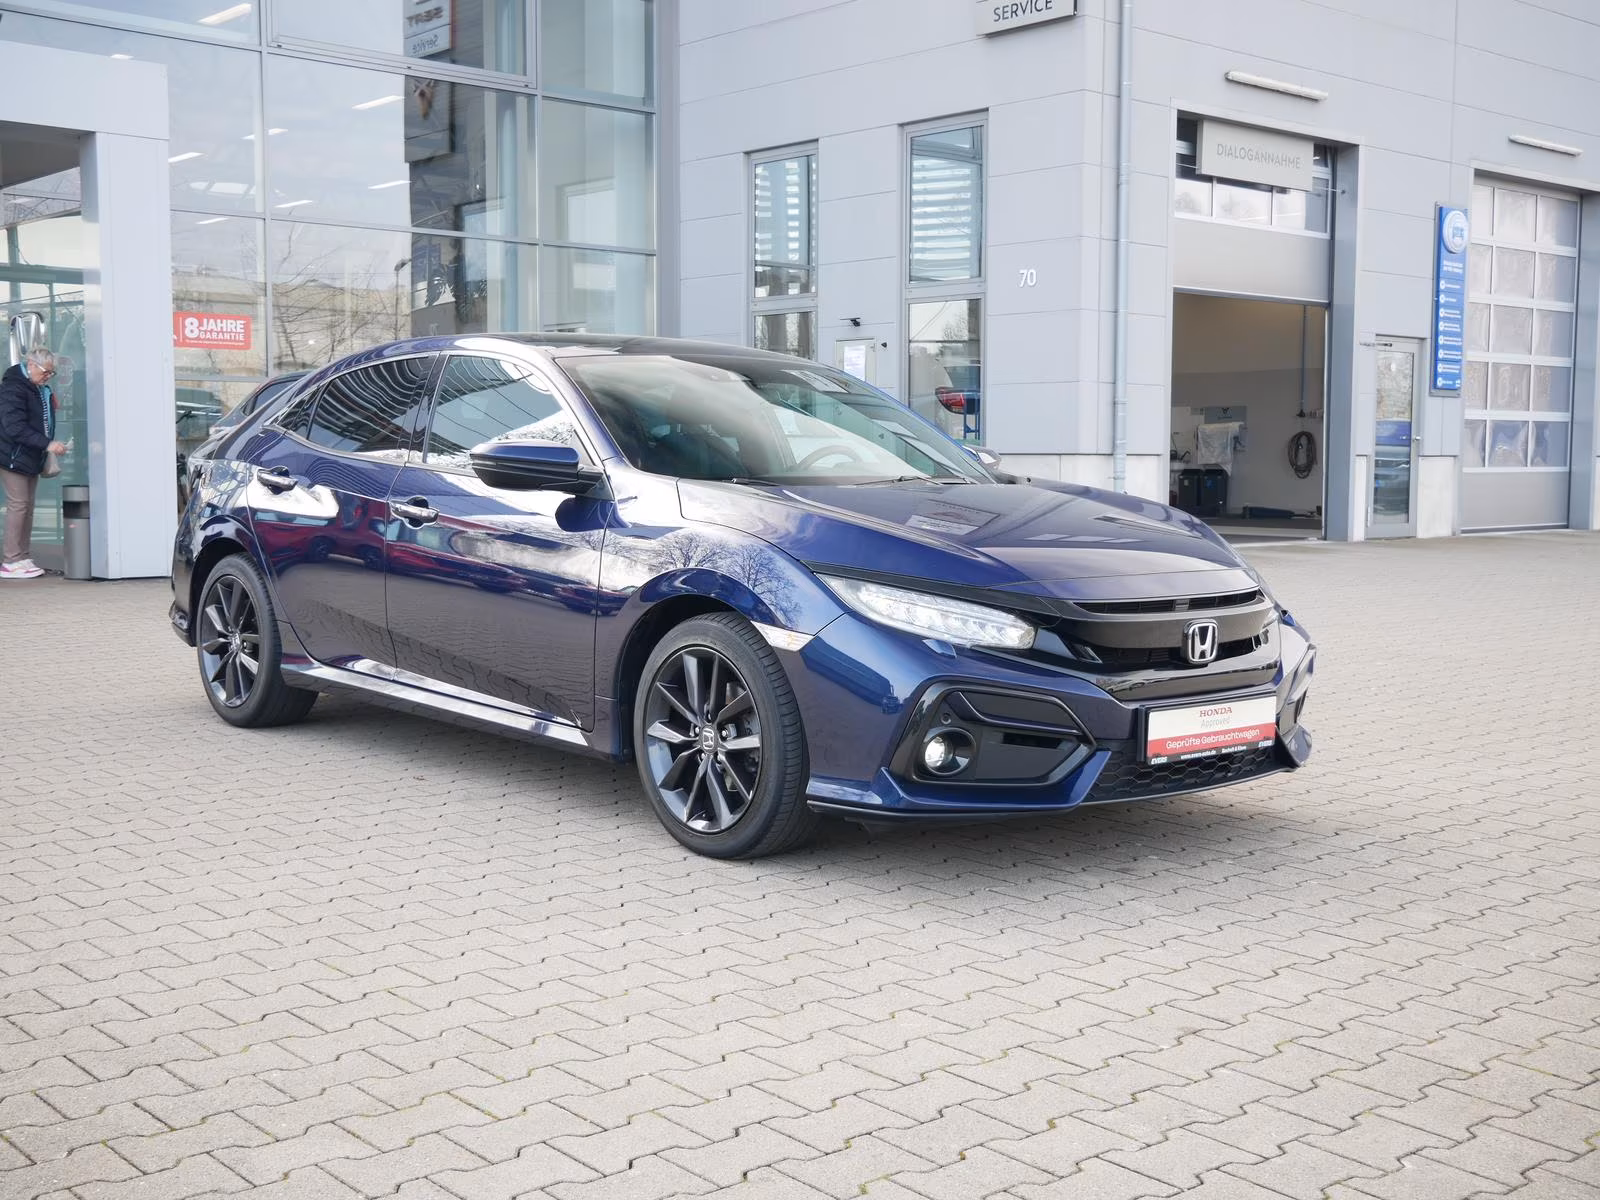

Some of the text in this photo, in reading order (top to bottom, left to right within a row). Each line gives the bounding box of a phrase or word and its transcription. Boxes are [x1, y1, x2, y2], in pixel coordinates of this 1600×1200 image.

[993, 0, 1053, 22] SERVICE
[1216, 143, 1301, 169] DIALOGANNAHME
[1019, 269, 1037, 288] 70
[184, 317, 246, 338] 8 JAHRE
[200, 331, 245, 341] GARANTIE
[1199, 707, 1233, 718] HONDA
[1200, 717, 1231, 729] Approved
[1166, 737, 1200, 750] Geprüfte
[1201, 728, 1260, 745] Gebrauchtwagen
